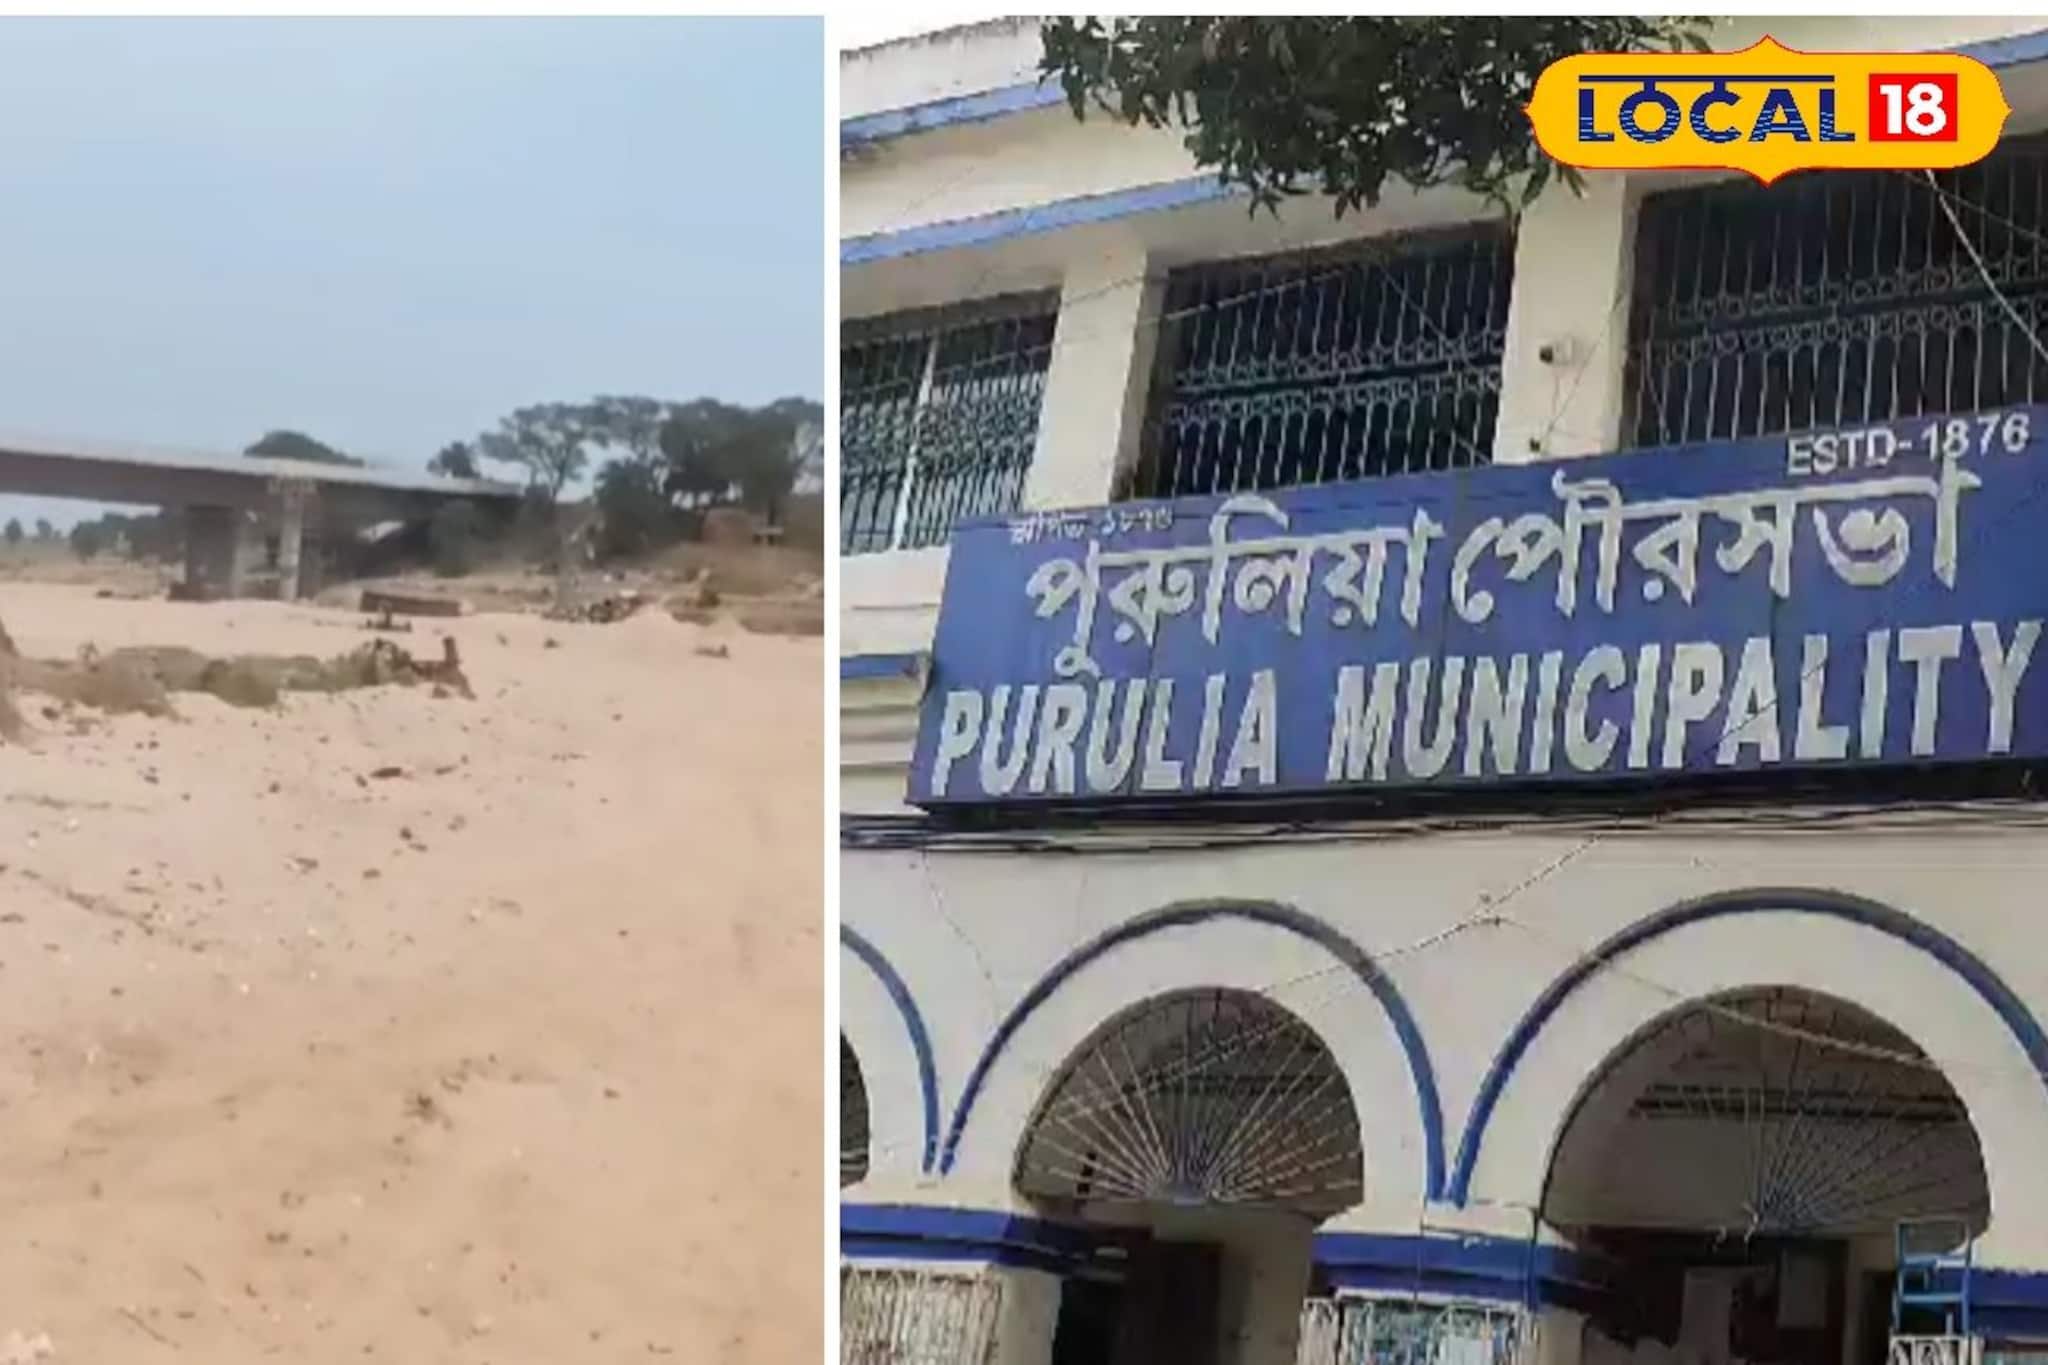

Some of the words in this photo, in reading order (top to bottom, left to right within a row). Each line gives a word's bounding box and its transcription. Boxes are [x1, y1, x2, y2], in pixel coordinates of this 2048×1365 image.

[1026, 494, 1444, 678] পুরুলিয়া
[1452, 451, 1981, 624] পৌরসভা
[931, 668, 1277, 797] PURULIA
[1325, 619, 2045, 782] MUNICIPALITY
